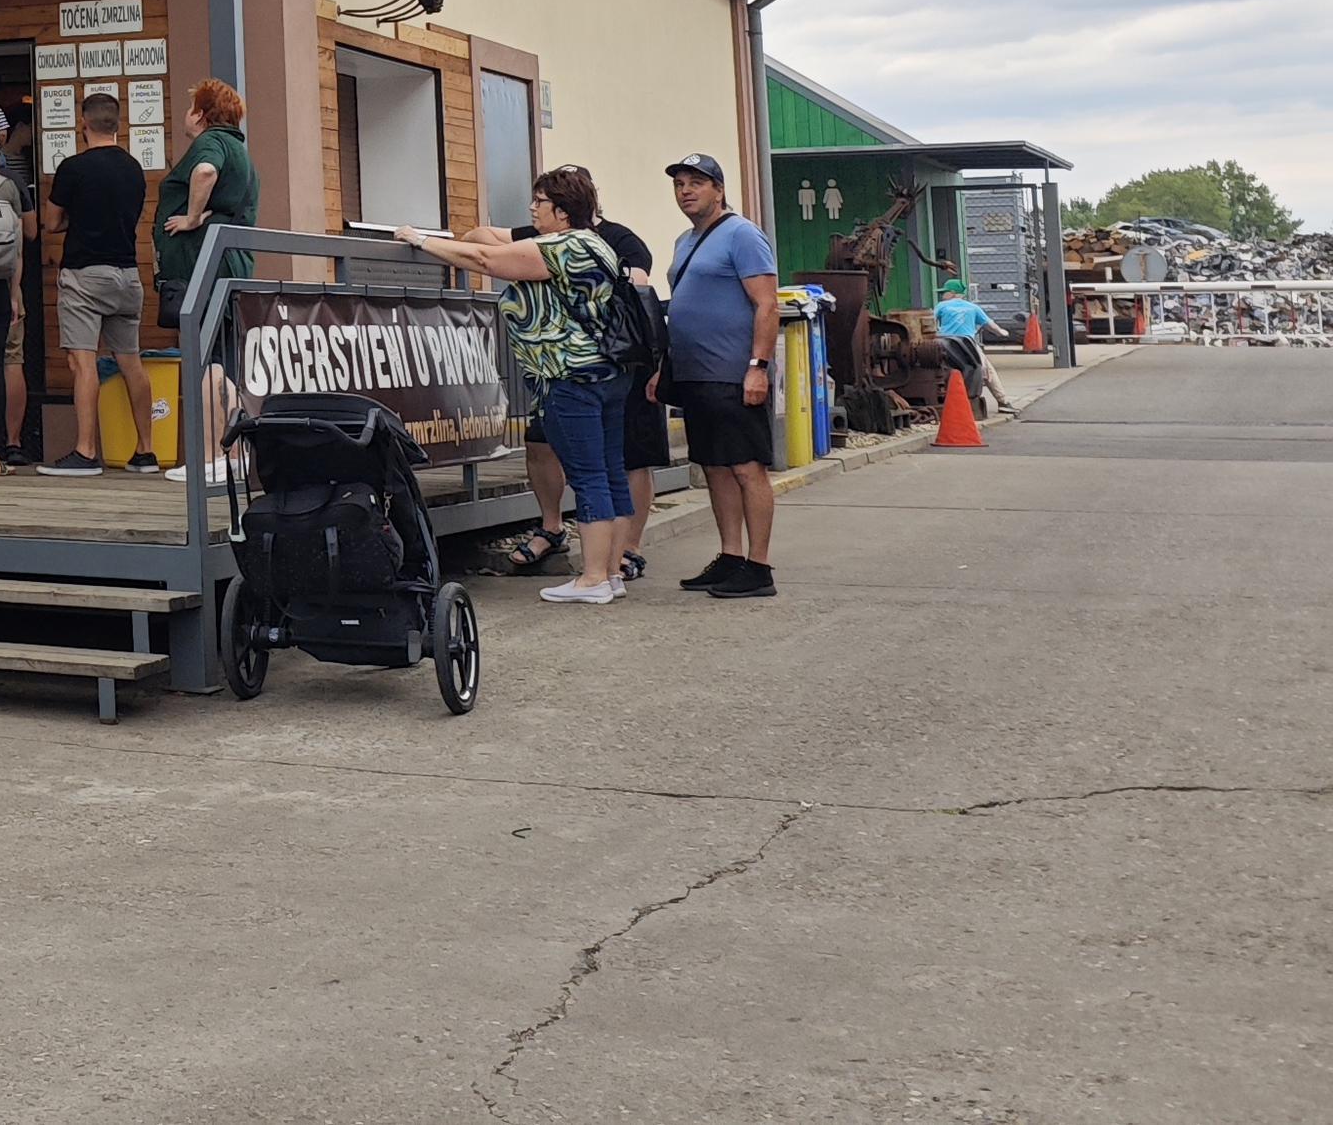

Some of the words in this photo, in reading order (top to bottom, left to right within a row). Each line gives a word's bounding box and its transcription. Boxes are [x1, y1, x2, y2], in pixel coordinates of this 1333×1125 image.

[61, 2, 100, 30] TOČENÁ
[101, 5, 141, 24] ZMRZLINA
[81, 42, 120, 69] VANILKOVÁ
[126, 40, 165, 66] JAHODOVÁ
[43, 90, 72, 98] BURGER
[244, 305, 413, 396] OBČERSTVENÍ
[408, 325, 430, 386] U
[426, 325, 500, 386] PAVOUKA
